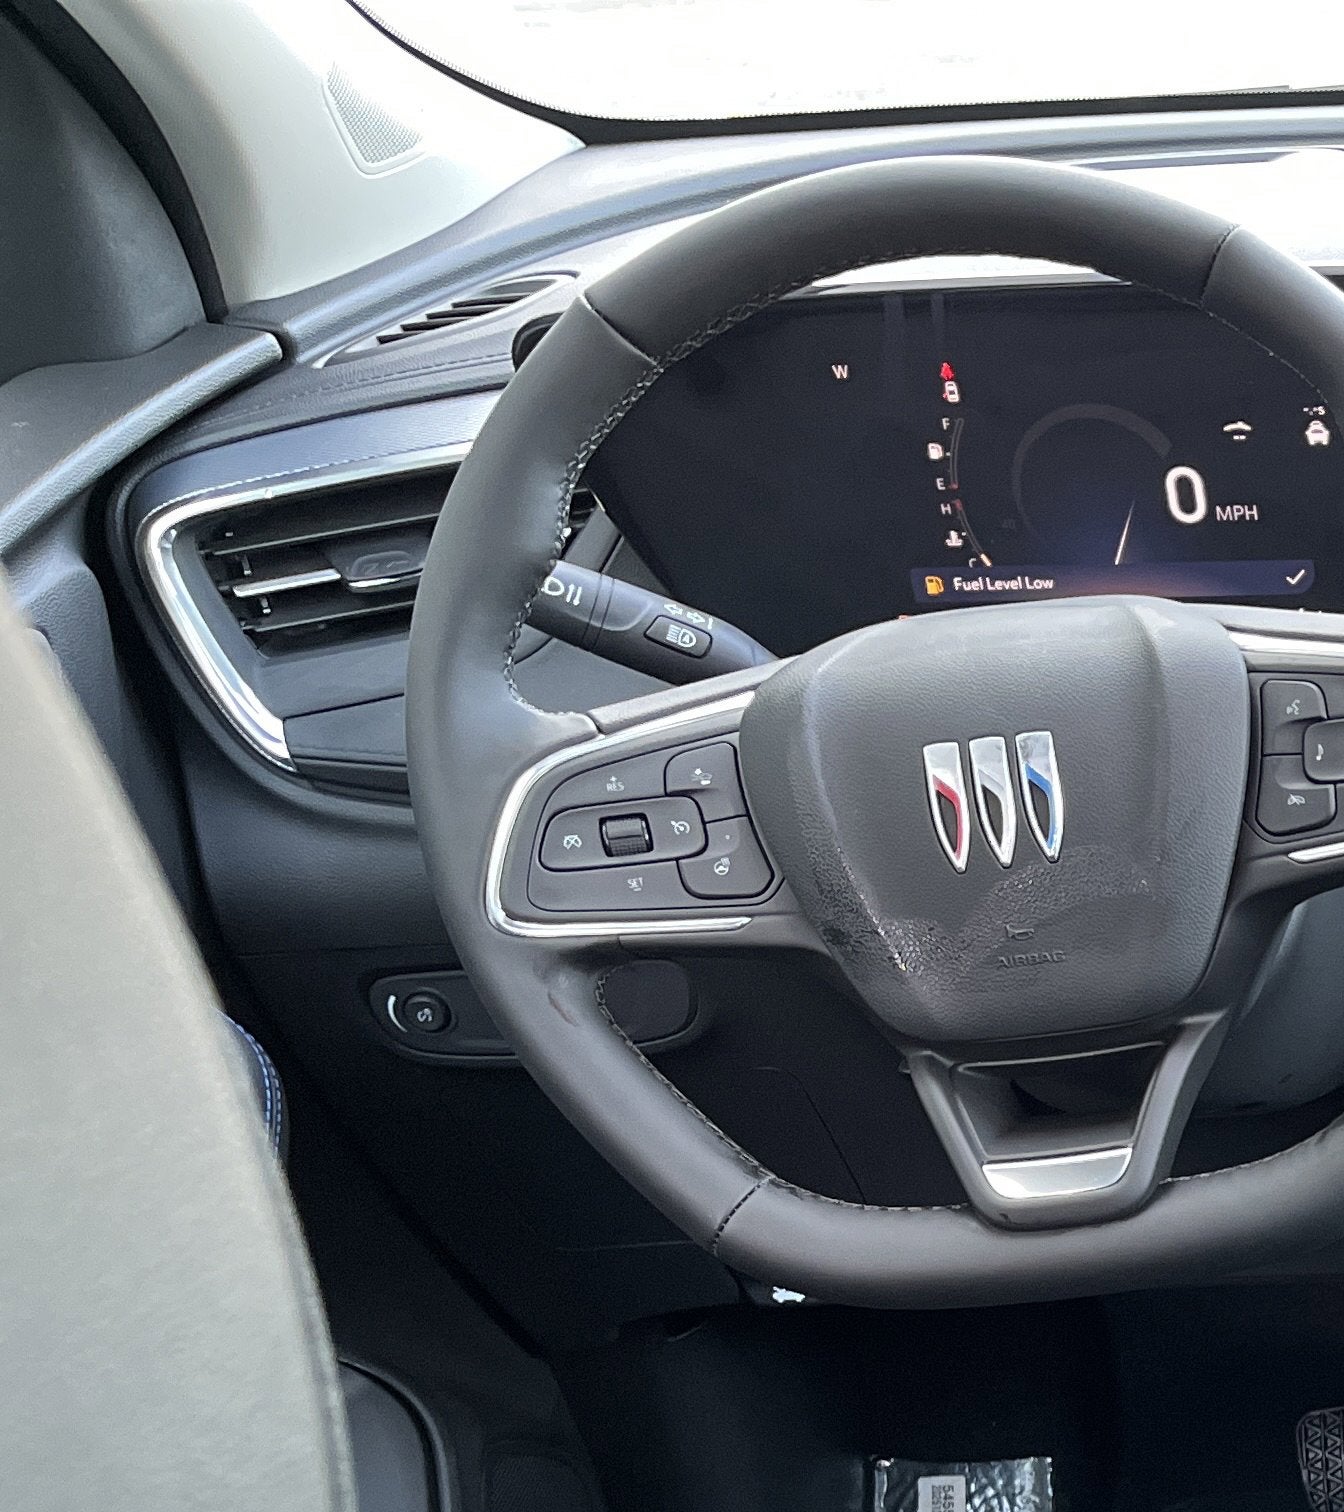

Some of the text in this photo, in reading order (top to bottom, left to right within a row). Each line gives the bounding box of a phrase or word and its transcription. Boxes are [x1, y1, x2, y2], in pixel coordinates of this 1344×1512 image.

[831, 364, 848, 379] W
[942, 418, 950, 430] F
[936, 477, 946, 490] E
[1166, 466, 1258, 524] 0 MPH
[940, 503, 951, 514] H
[953, 576, 1054, 591] Fuel Level Low
[606, 781, 625, 792] RES
[997, 950, 1066, 969] AIRBAG
